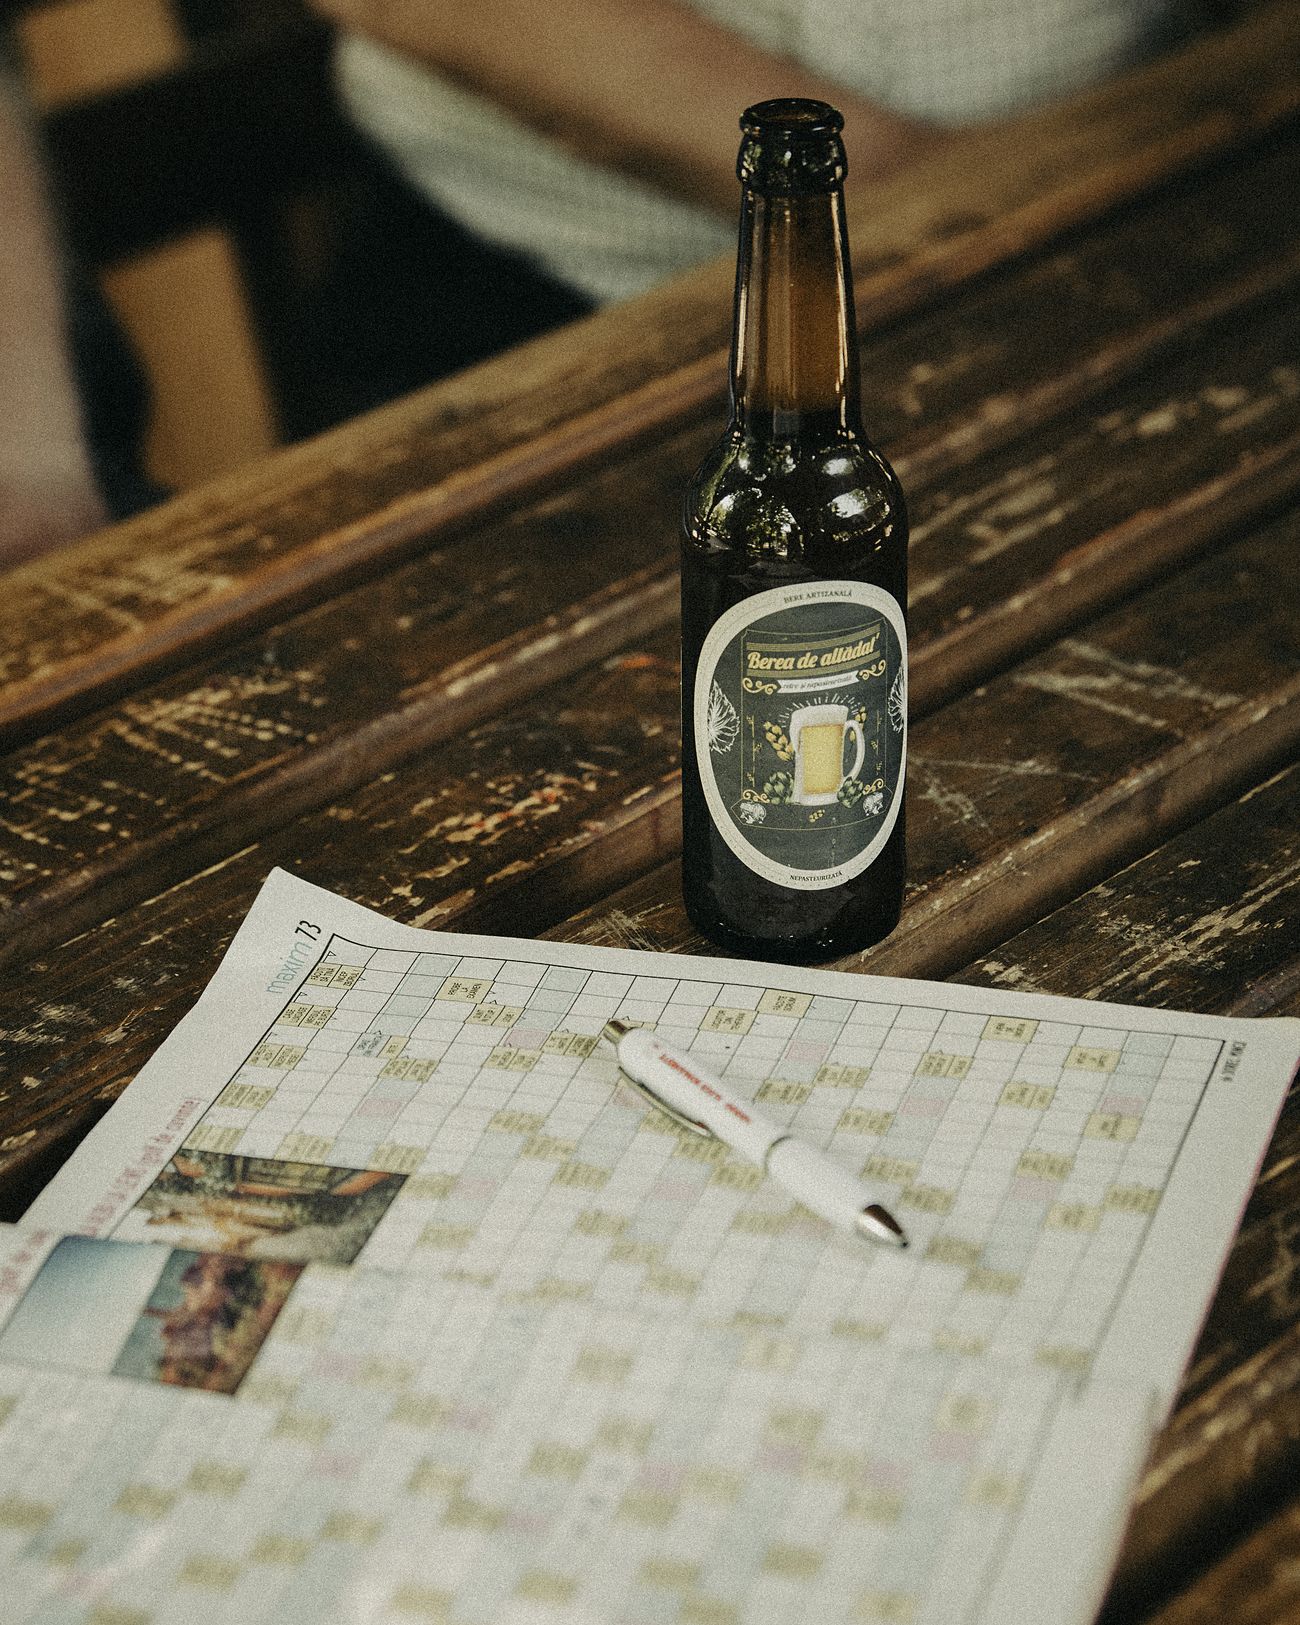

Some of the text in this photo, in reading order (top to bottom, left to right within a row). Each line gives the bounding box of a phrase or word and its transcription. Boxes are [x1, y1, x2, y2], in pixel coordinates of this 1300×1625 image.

[747, 652, 796, 670] Berea
[796, 652, 818, 669] de
[266, 941, 312, 993] maxim
